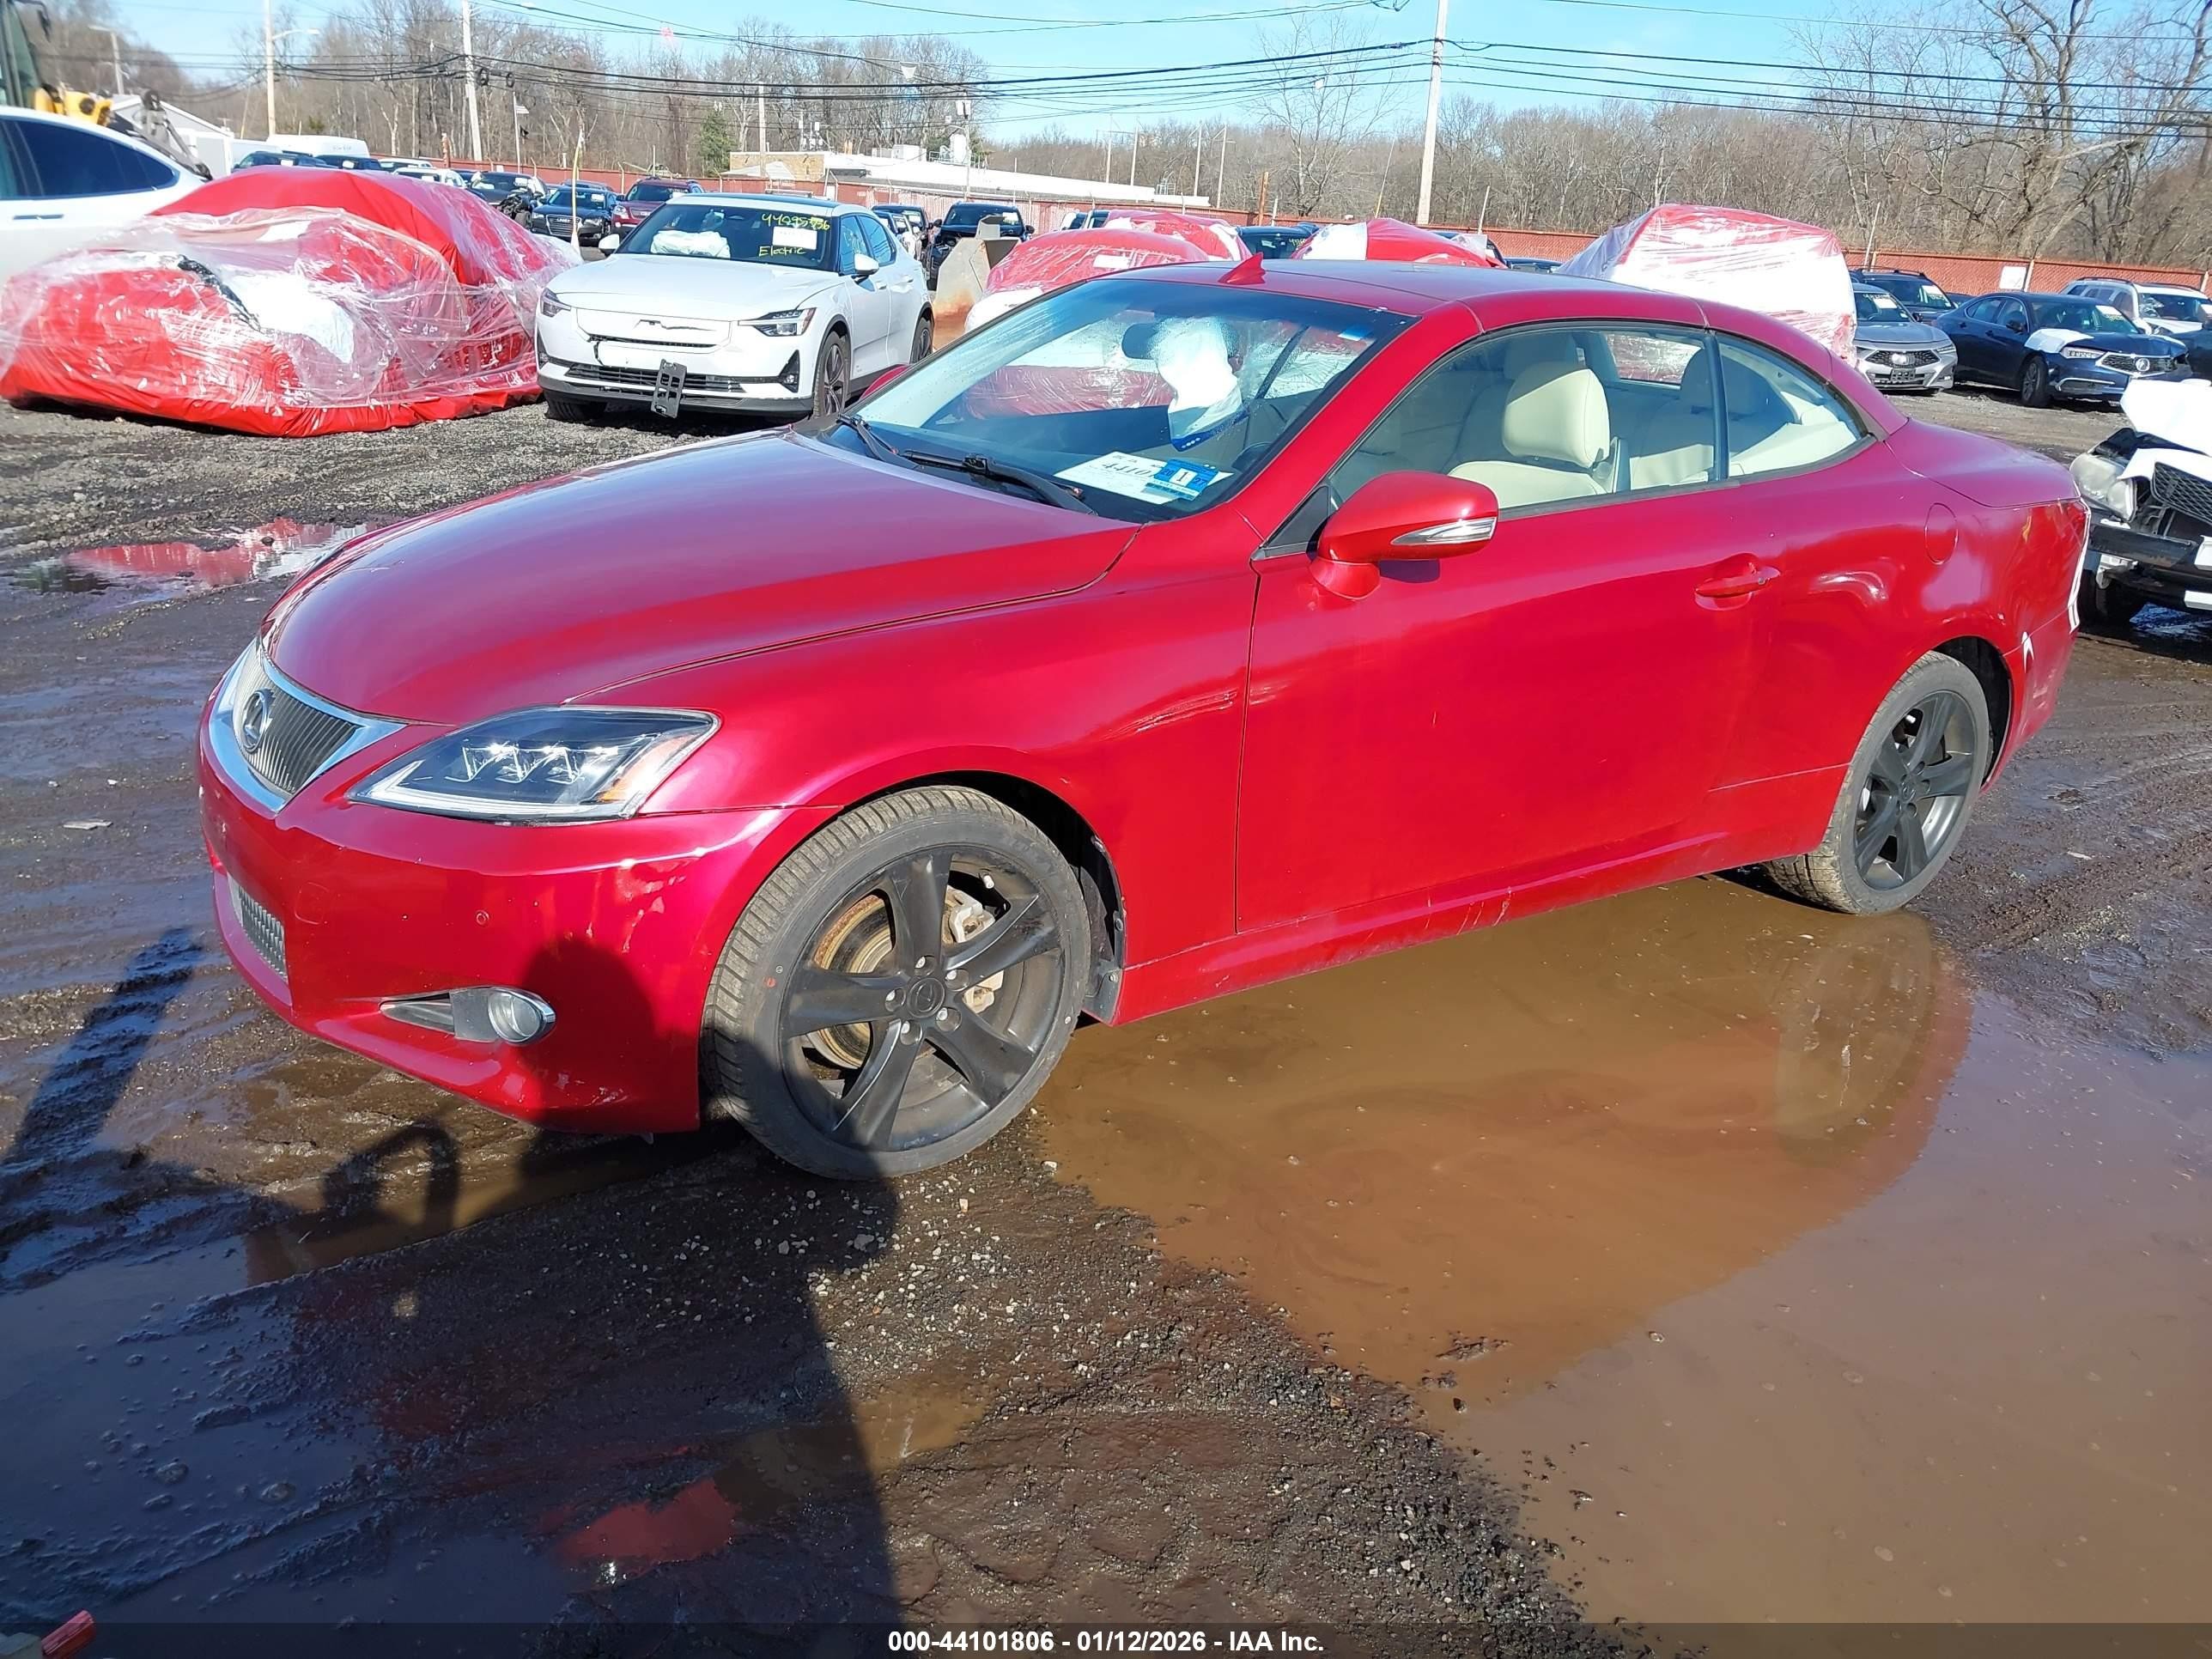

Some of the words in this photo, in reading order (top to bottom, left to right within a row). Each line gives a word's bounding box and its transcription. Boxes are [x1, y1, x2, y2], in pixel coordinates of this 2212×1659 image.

[758, 246, 806, 258] Electric
[1102, 463, 1155, 477] 4410
[1176, 471, 1189, 482] 1
[1194, 477, 1206, 487] 27
